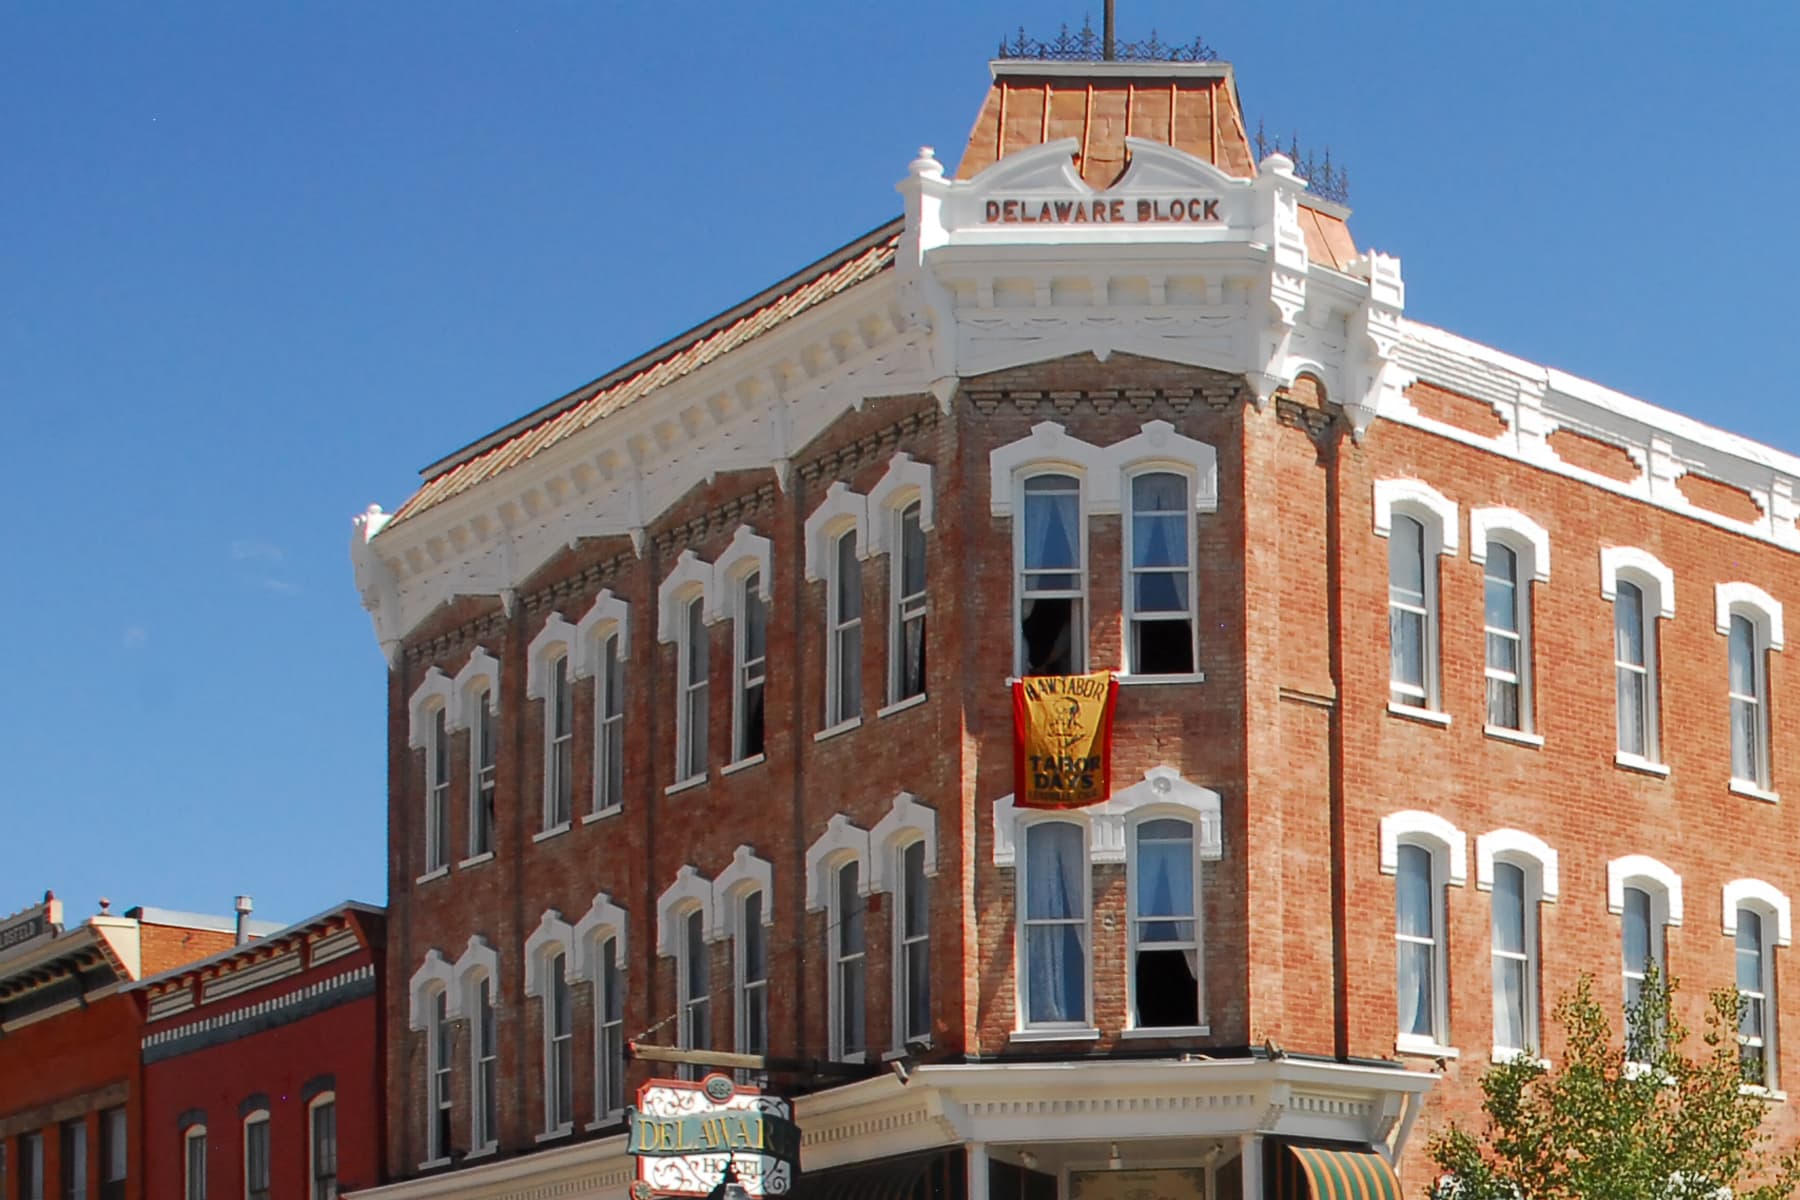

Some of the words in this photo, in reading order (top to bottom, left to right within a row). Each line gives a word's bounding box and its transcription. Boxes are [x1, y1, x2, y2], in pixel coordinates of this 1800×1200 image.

[985, 198, 1125, 223] DELAWARE
[1137, 197, 1221, 222] BLOCK
[1058, 676, 1105, 702] TABOR
[1029, 754, 1101, 772] TABOR
[1034, 772, 1095, 790] DAYS
[637, 1115, 780, 1152] DELAWAR
